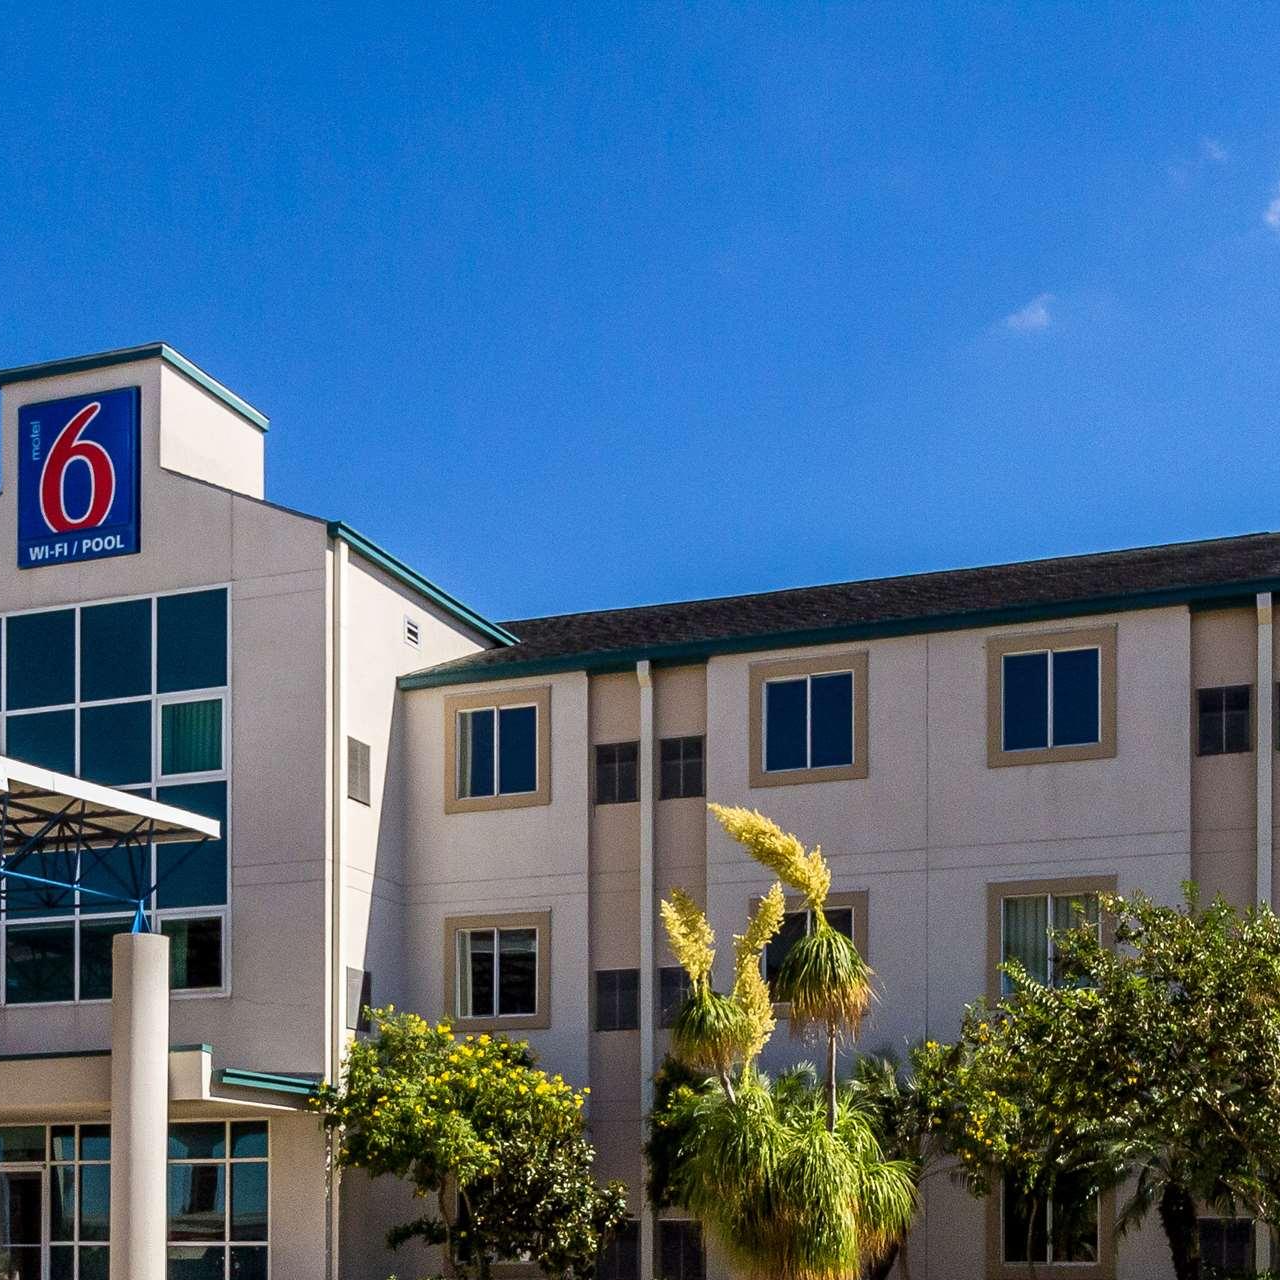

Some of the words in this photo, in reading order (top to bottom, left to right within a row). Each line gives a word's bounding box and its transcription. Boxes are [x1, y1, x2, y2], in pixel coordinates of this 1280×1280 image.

[30, 420, 40, 461] motel
[39, 401, 116, 533] 6
[29, 542, 68, 561] WI-FI
[82, 534, 125, 554] POOL
